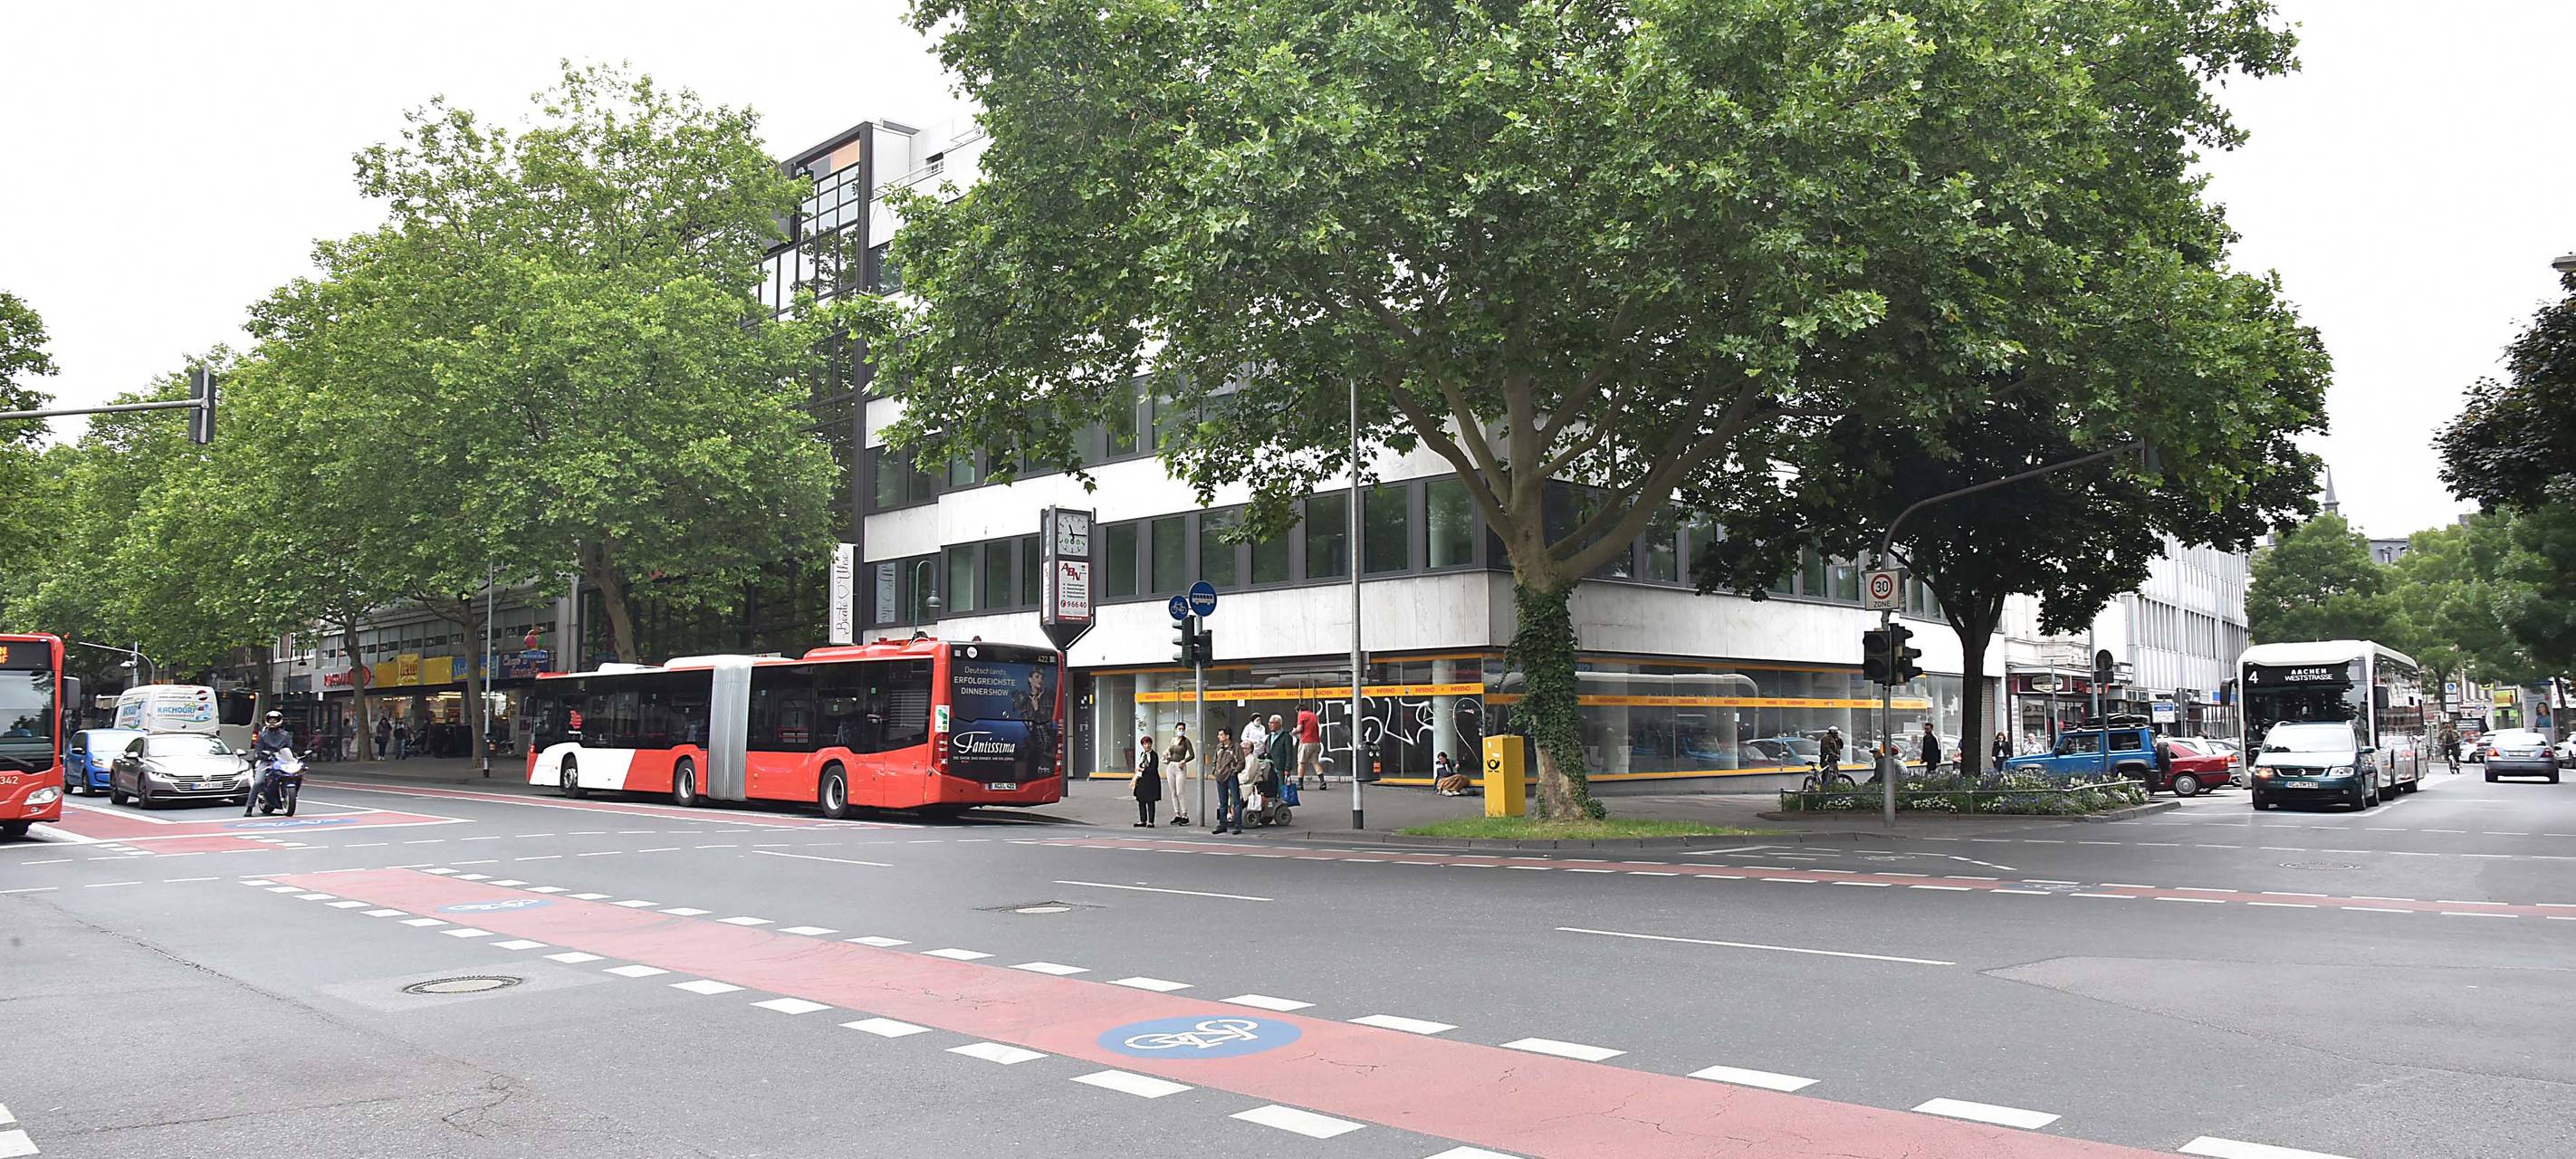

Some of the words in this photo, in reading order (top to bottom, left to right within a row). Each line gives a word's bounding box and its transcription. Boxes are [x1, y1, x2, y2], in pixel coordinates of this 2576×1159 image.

[1060, 562, 1081, 581] ABN
[1875, 580, 1889, 592] 30
[835, 601, 851, 637] Beate
[964, 666, 1007, 675] Deutschlands
[953, 675, 1016, 686] ERFOLGREICHSTE
[2247, 670, 2259, 685] 4
[2284, 674, 2333, 682] WESTSTRASSE
[961, 686, 1009, 696] DINNERSHOW
[953, 731, 1016, 754] Fantissima
[0, 776, 19, 785] 342
